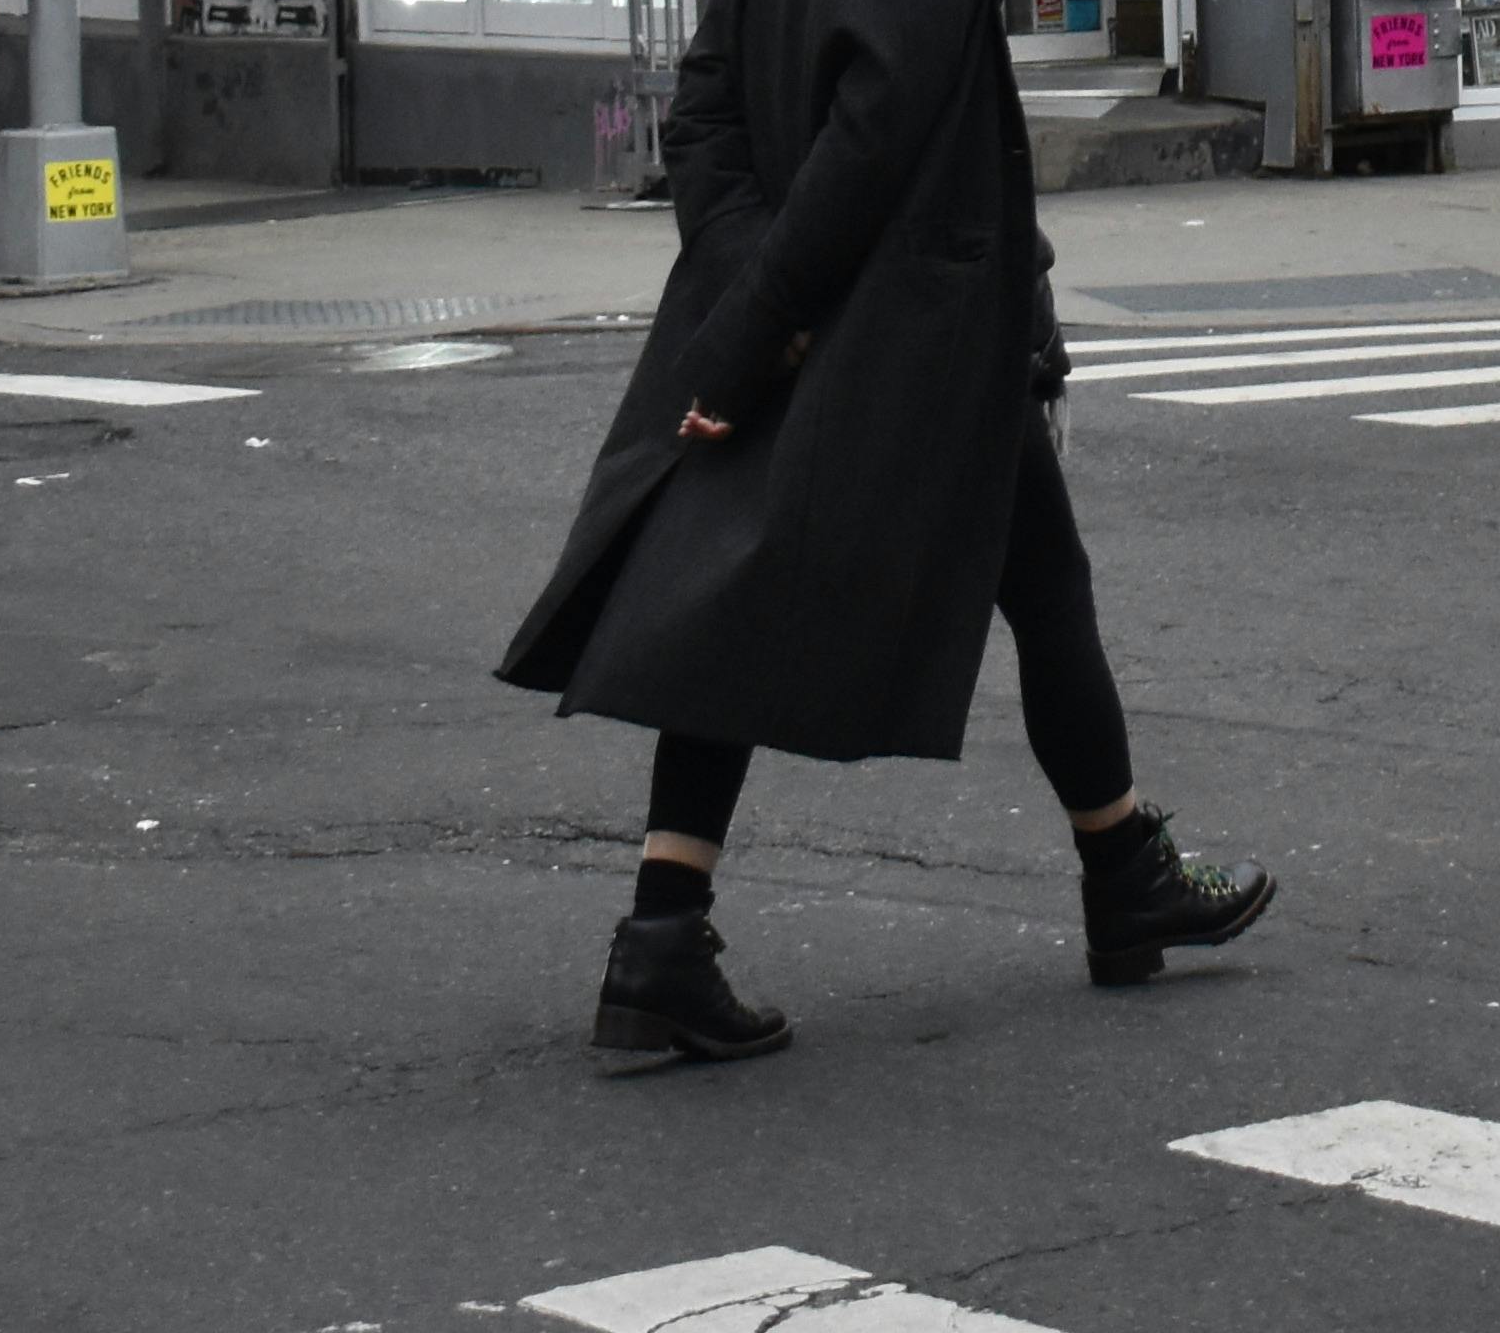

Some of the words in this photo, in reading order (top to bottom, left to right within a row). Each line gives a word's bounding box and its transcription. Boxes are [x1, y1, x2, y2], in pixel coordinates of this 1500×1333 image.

[1373, 17, 1422, 39] FRIENDS
[1475, 19, 1497, 39] AD
[1373, 55, 1394, 69] NEW
[1399, 53, 1425, 66] YORK
[49, 164, 112, 188] FRIENDS
[50, 204, 77, 219] NEW
[82, 202, 113, 216] YORK
